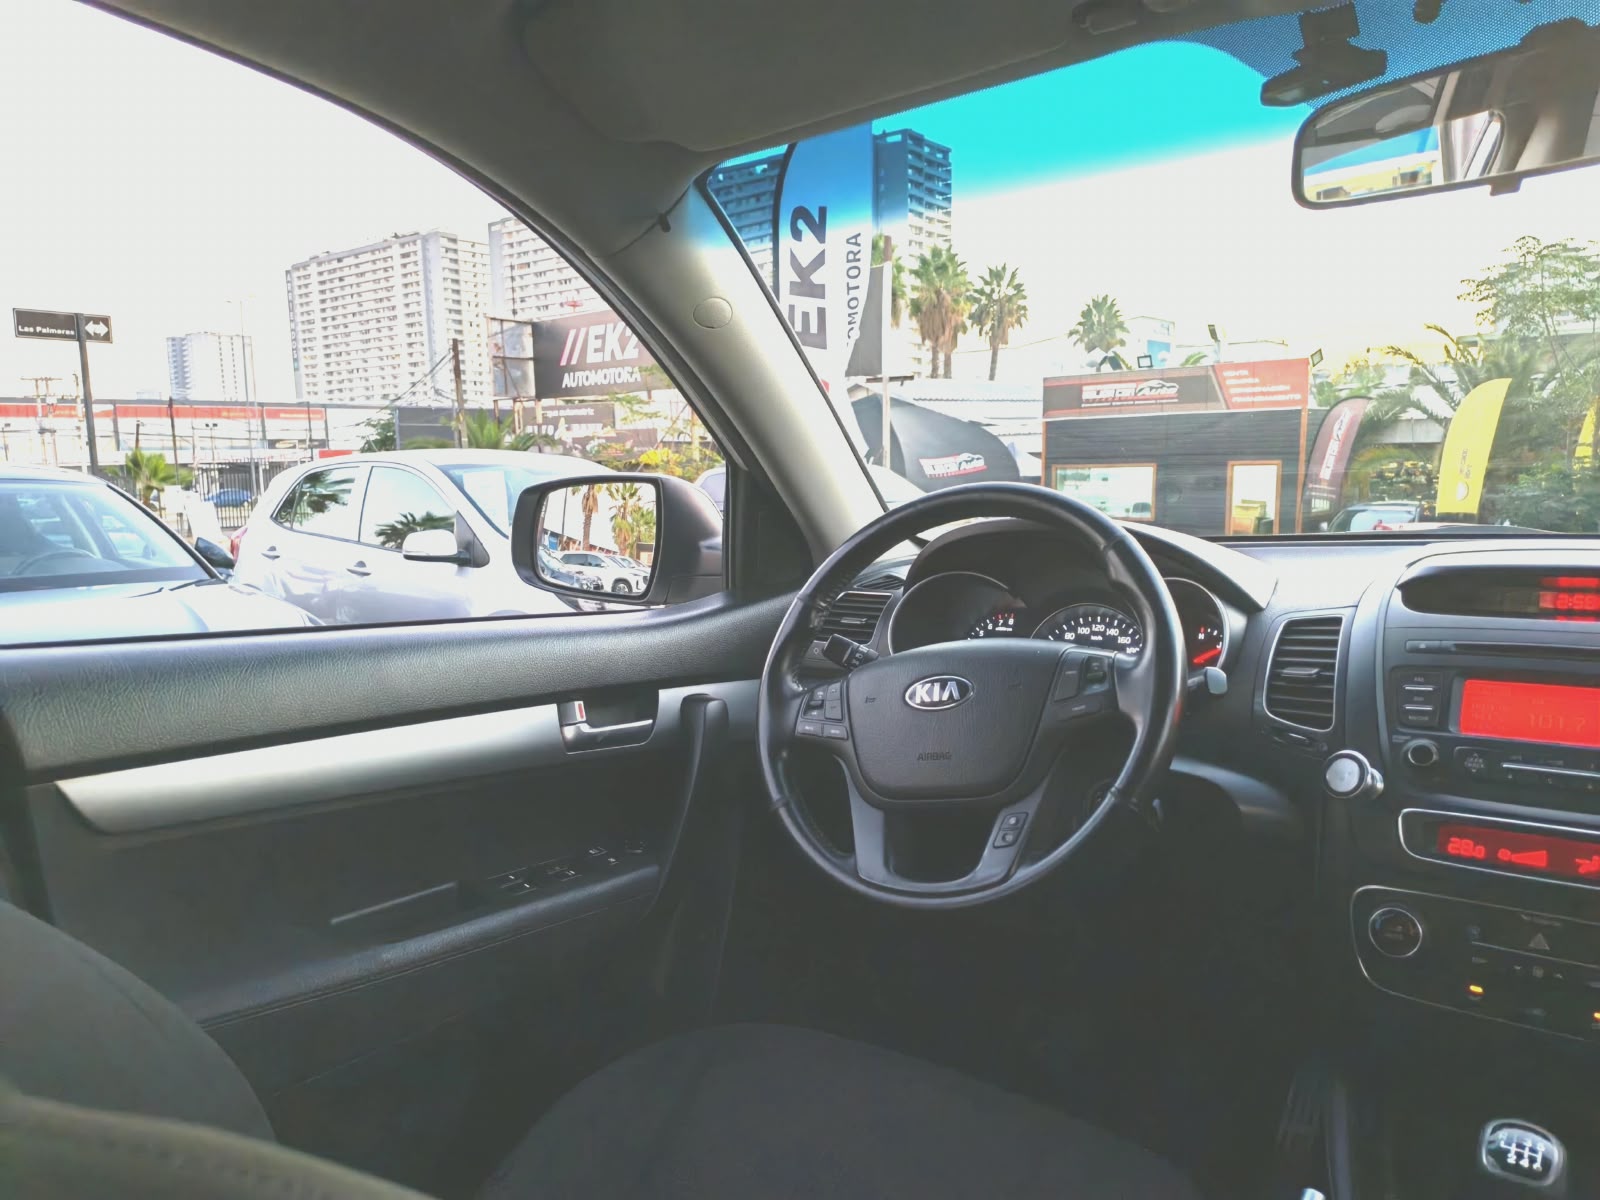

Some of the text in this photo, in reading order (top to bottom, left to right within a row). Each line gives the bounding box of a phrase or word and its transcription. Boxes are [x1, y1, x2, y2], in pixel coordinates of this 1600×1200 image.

[788, 205, 827, 350] EK2
[18, 325, 75, 335] Las Palmeras
[562, 366, 641, 389] AUTOMOTORA
[1064, 632, 1075, 640] 80
[1106, 628, 1119, 636] 140
[1117, 636, 1131, 644] 160
[915, 681, 961, 704] KIA
